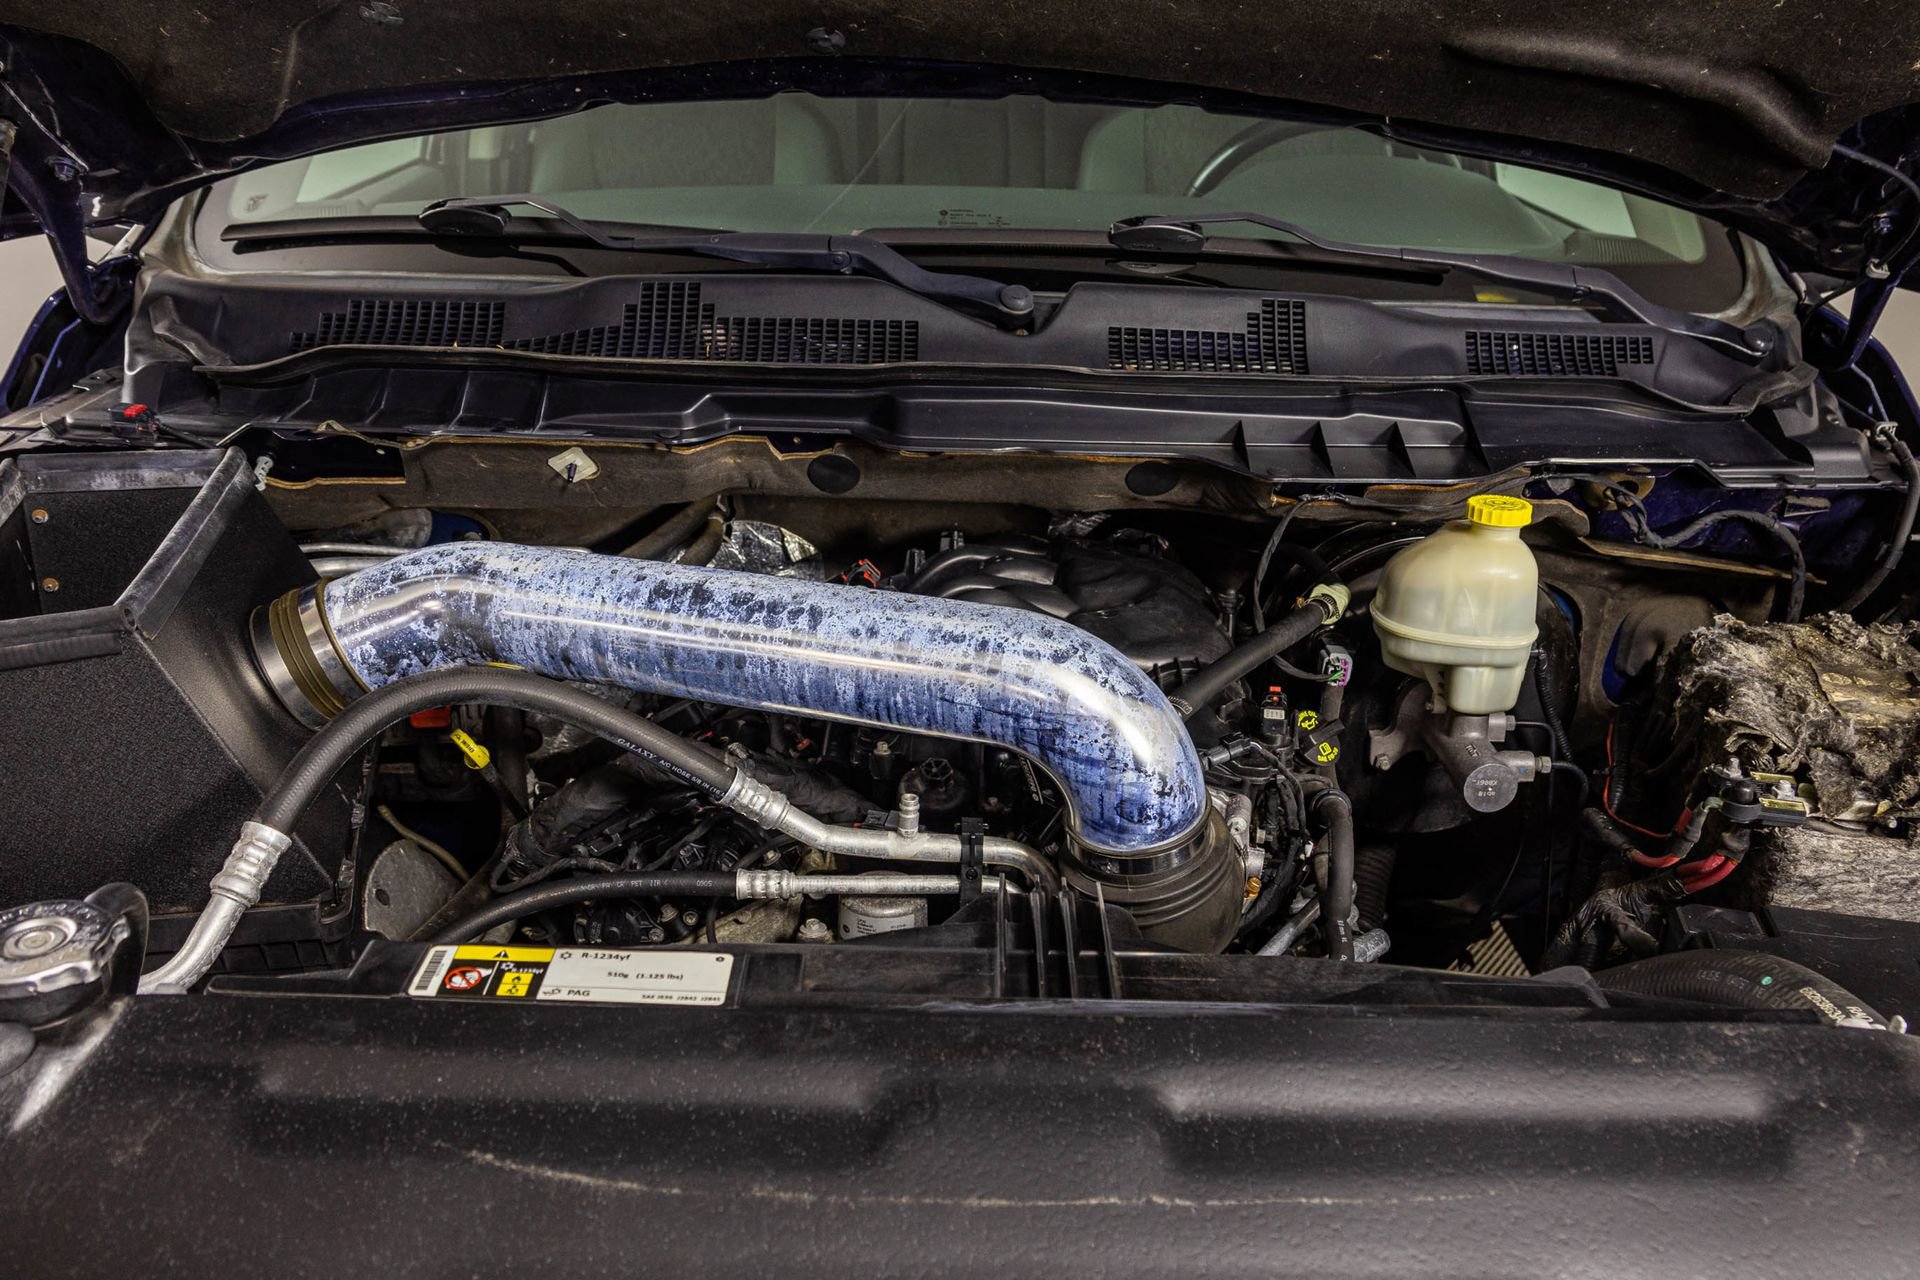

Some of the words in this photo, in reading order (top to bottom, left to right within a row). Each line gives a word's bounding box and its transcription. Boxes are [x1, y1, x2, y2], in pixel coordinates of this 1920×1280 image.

[617, 738, 657, 760] GALAXY
[659, 759, 672, 769] A/C
[671, 765, 691, 779] HOSE
[581, 952, 631, 962] R-1234yf
[607, 972, 629, 980] 510g
[666, 973, 684, 981] lbs)
[567, 989, 591, 997] PAG
